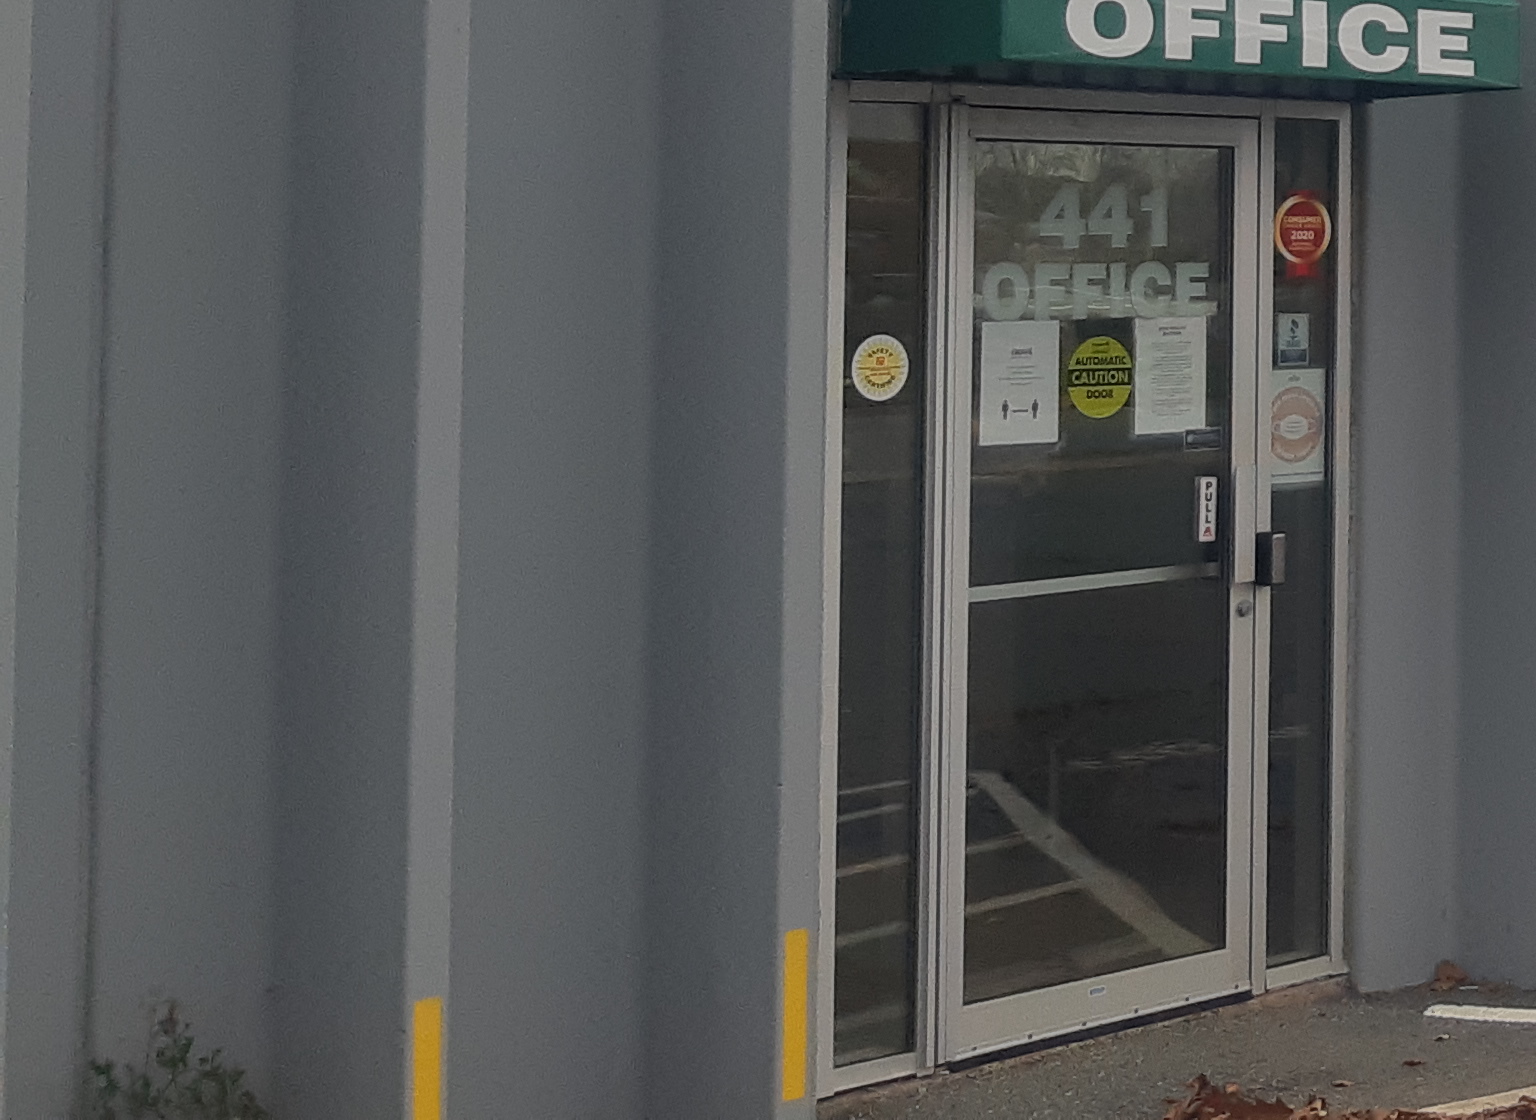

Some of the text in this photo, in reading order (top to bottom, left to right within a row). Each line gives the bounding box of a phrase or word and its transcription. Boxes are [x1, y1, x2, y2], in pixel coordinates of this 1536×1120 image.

[1039, 181, 1169, 249] 441
[1290, 230, 1315, 240] 2020
[982, 260, 1210, 322] OFFICE
[1075, 356, 1127, 366] AUTOMATIC
[1072, 370, 1129, 385] CAUTION
[1086, 389, 1114, 399] DOOR
[1204, 481, 1213, 524] PULL
